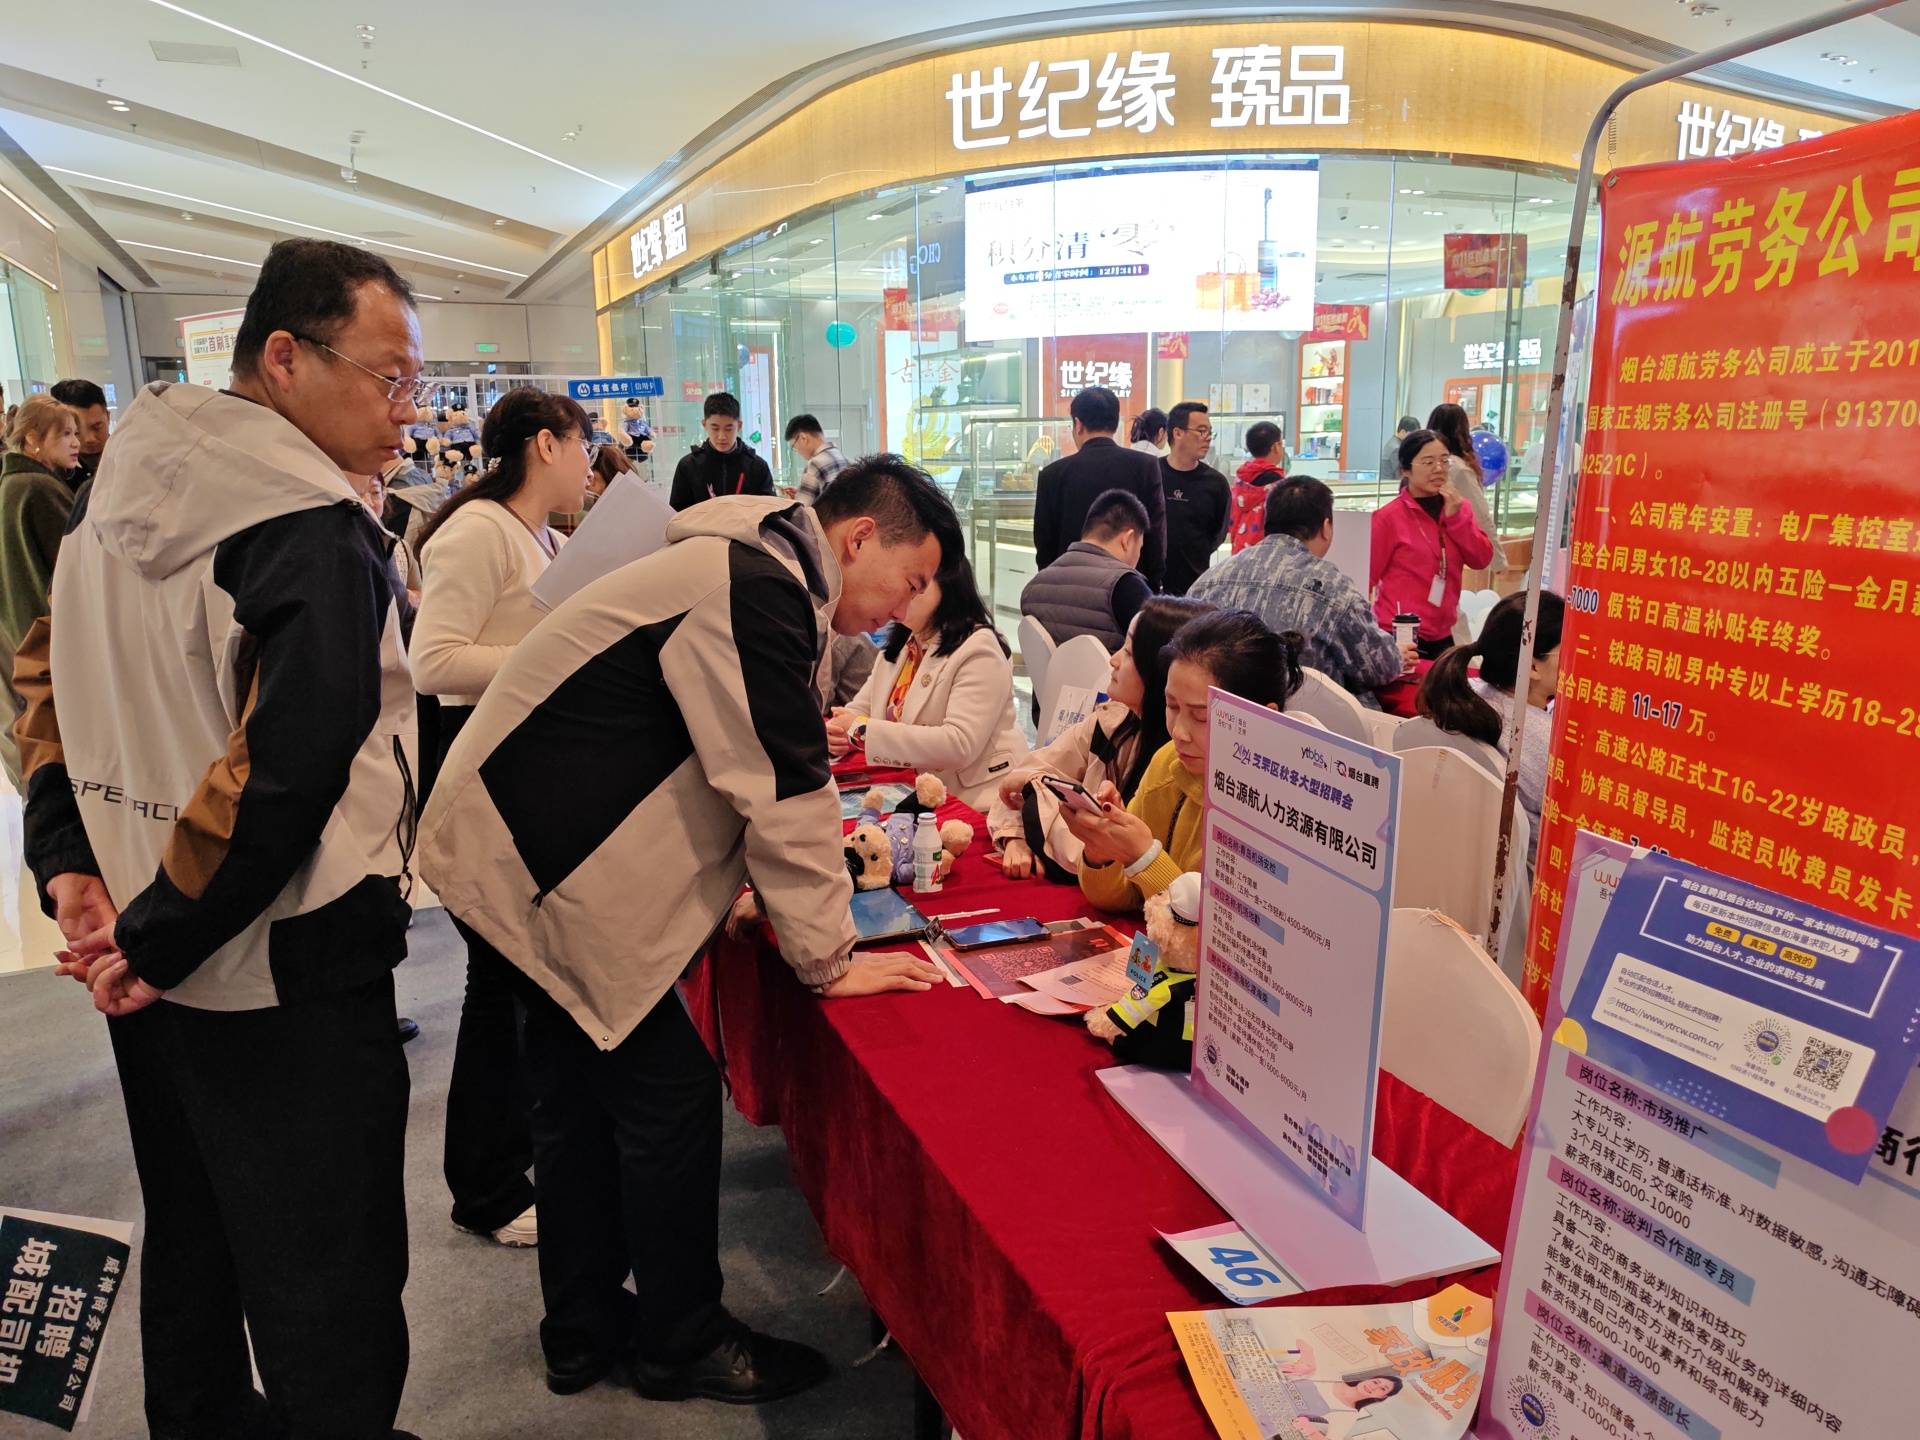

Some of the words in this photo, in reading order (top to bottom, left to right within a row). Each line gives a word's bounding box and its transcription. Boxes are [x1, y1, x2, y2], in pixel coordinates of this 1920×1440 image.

[945, 50, 1176, 150] 世纪缘
[1211, 44, 1350, 128] 臻品
[1610, 167, 1920, 307] 源航劳务公司
[592, 383, 629, 393] 招商银行
[1060, 360, 1133, 389] 世纪缘
[1619, 338, 1920, 383] 烟台源航劳务公司成立于201
[1585, 398, 1920, 433] 国家正规劳务公司注册号（91370
[1607, 591, 1831, 661] 假节日高温补贴年终奖。
[1633, 691, 1682, 729] 11-17
[1252, 752, 1354, 811] 芝罘区秋冬大型招聘会
[1348, 766, 1379, 790] 烟台直聘
[1213, 769, 1377, 870] 烟台源航人力资源有限公司
[1680, 878, 1881, 949] 烟台直聘是烟台论坛旗下的一家本地招聘网站
[1691, 899, 1850, 958] 每日更新本地招聘信息和海量求职人才
[1684, 932, 1827, 991] 助力烟台人才、企业的求职与发展
[1713, 926, 1733, 940] 免费
[1749, 937, 1770, 951] 真实
[1782, 949, 1813, 967] 高效的
[1615, 999, 1725, 1051] https://www.ytrcw.com.cn/
[1573, 1090, 1633, 1130] 工作内容：
[1578, 1064, 1708, 1139] 岗位名称:市场推广
[1555, 1193, 1613, 1237] 工作内容：
[1564, 1145, 1691, 1230] 薪资待遇5000-10000
[1559, 1169, 1736, 1293] 岗位名称:谈判合作部专员
[1208, 1247, 1282, 1287] 46
[1551, 1212, 1747, 1348] 具备一定的商务谈判知识和技巧
[35, 1284, 87, 1359] 招聘
[1532, 1323, 1587, 1374] 工作内容：
[1540, 1279, 1661, 1375] 薪资待遇6000-10000
[1543, 1262, 1765, 1429] 不断提升自己的专业素养和综合能力
[1545, 1244, 1769, 1409] 能够准确地向酒店方进行介绍和解释
[1549, 1228, 1843, 1434] 了解公司定制瓶装水置换客房业务的详细内容
